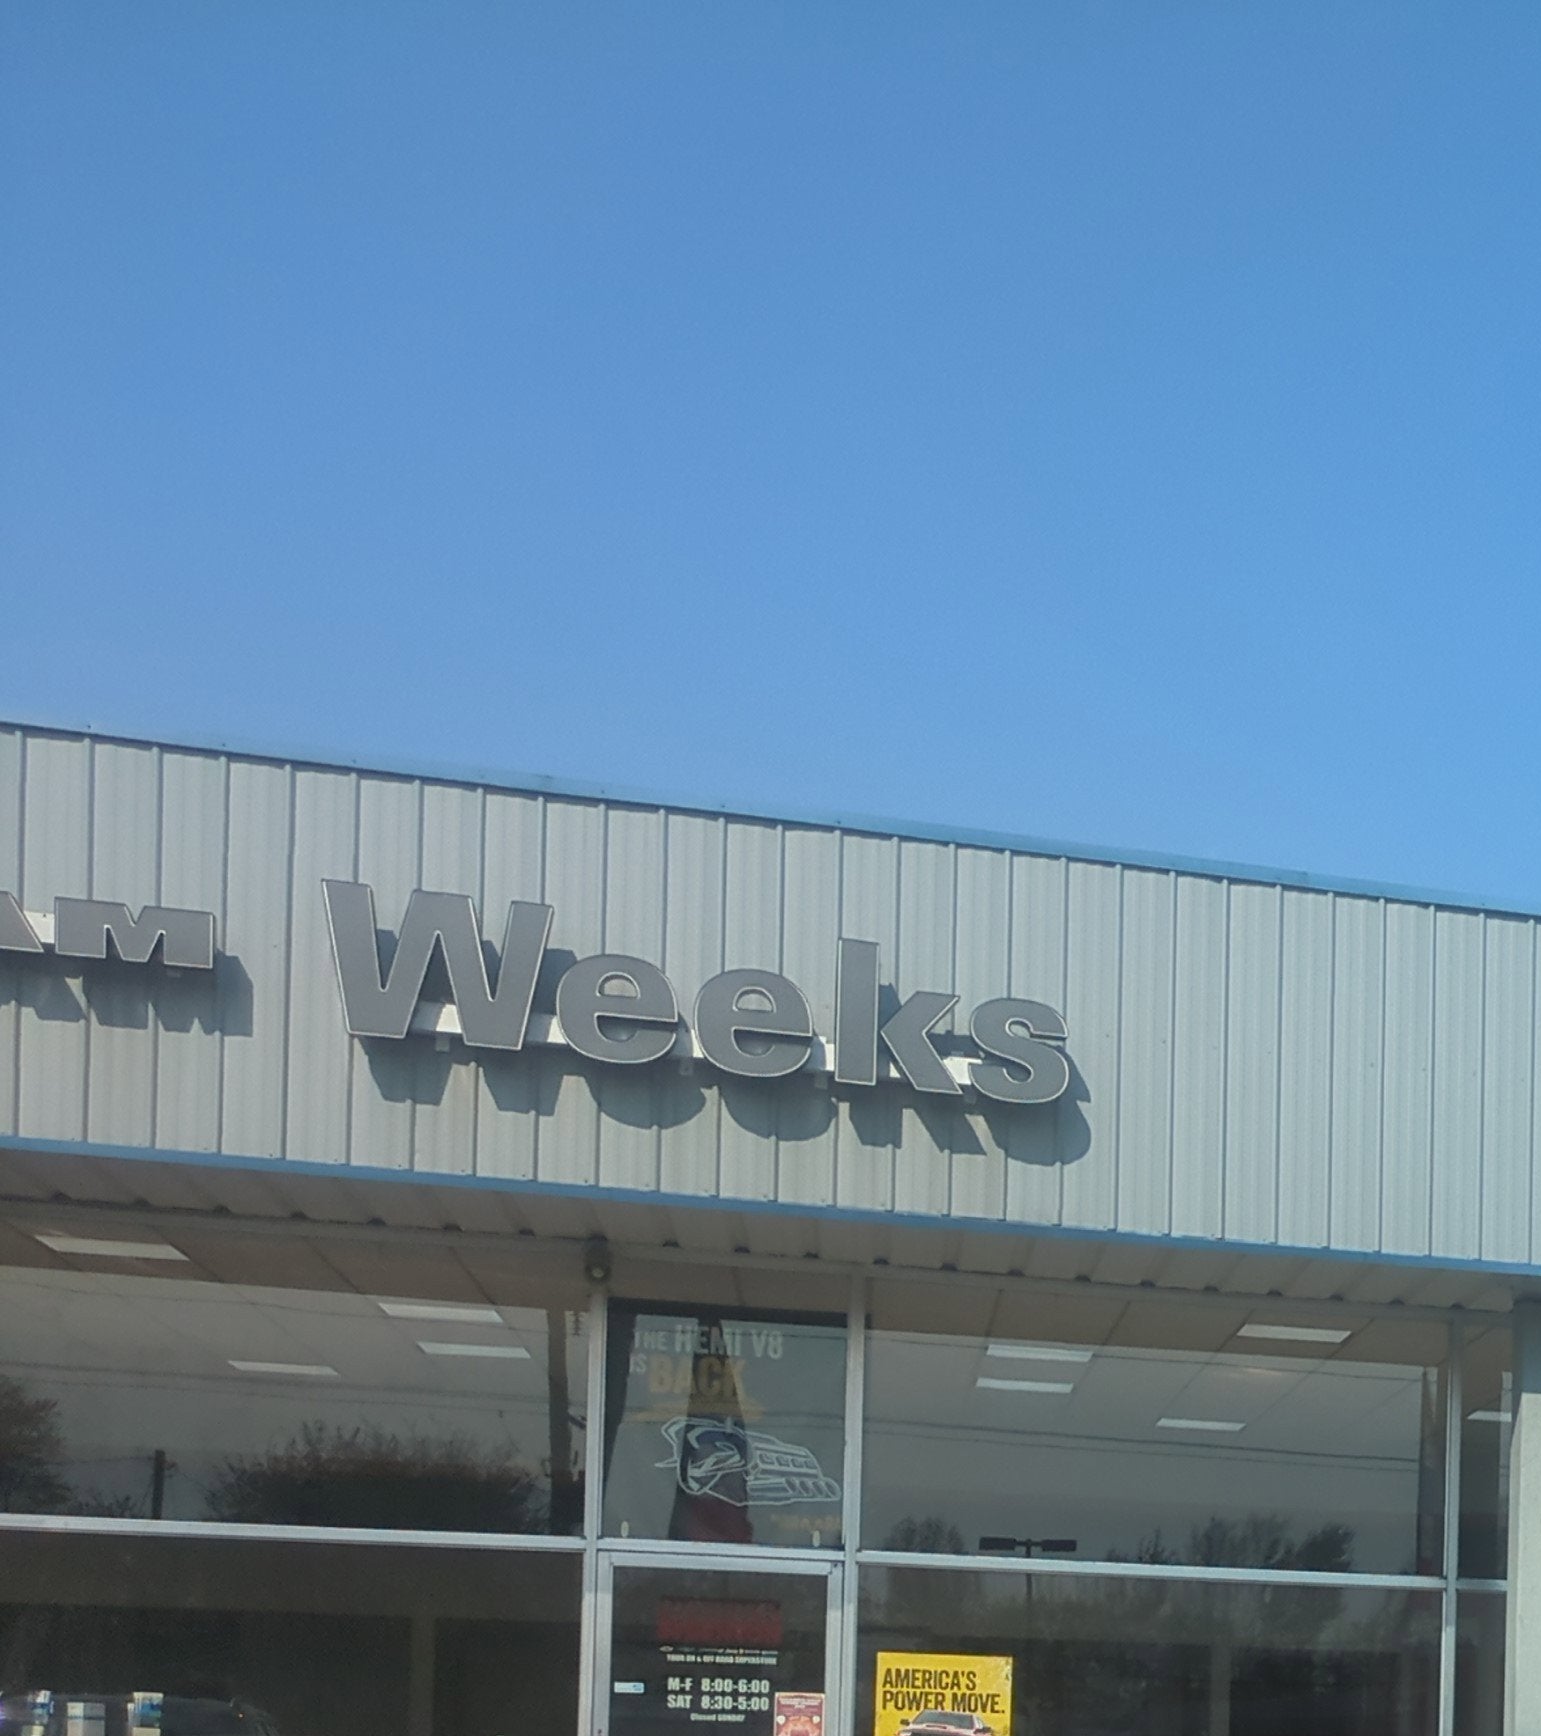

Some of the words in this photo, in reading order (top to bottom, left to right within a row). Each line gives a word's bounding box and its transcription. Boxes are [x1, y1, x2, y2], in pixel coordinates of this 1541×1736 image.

[321, 878, 1071, 1103] Weeks
[751, 1329, 783, 1360] V8
[650, 1353, 746, 1396] BACK
[667, 1677, 693, 1691] M-F
[701, 1678, 770, 1693] 8:00-6:00
[882, 1667, 977, 1691] AMERICA'S
[666, 1694, 693, 1709] SAT
[700, 1695, 770, 1711] 8:30-5:00
[882, 1690, 946, 1712] POWER
[951, 1693, 1005, 1714] MOVE.
